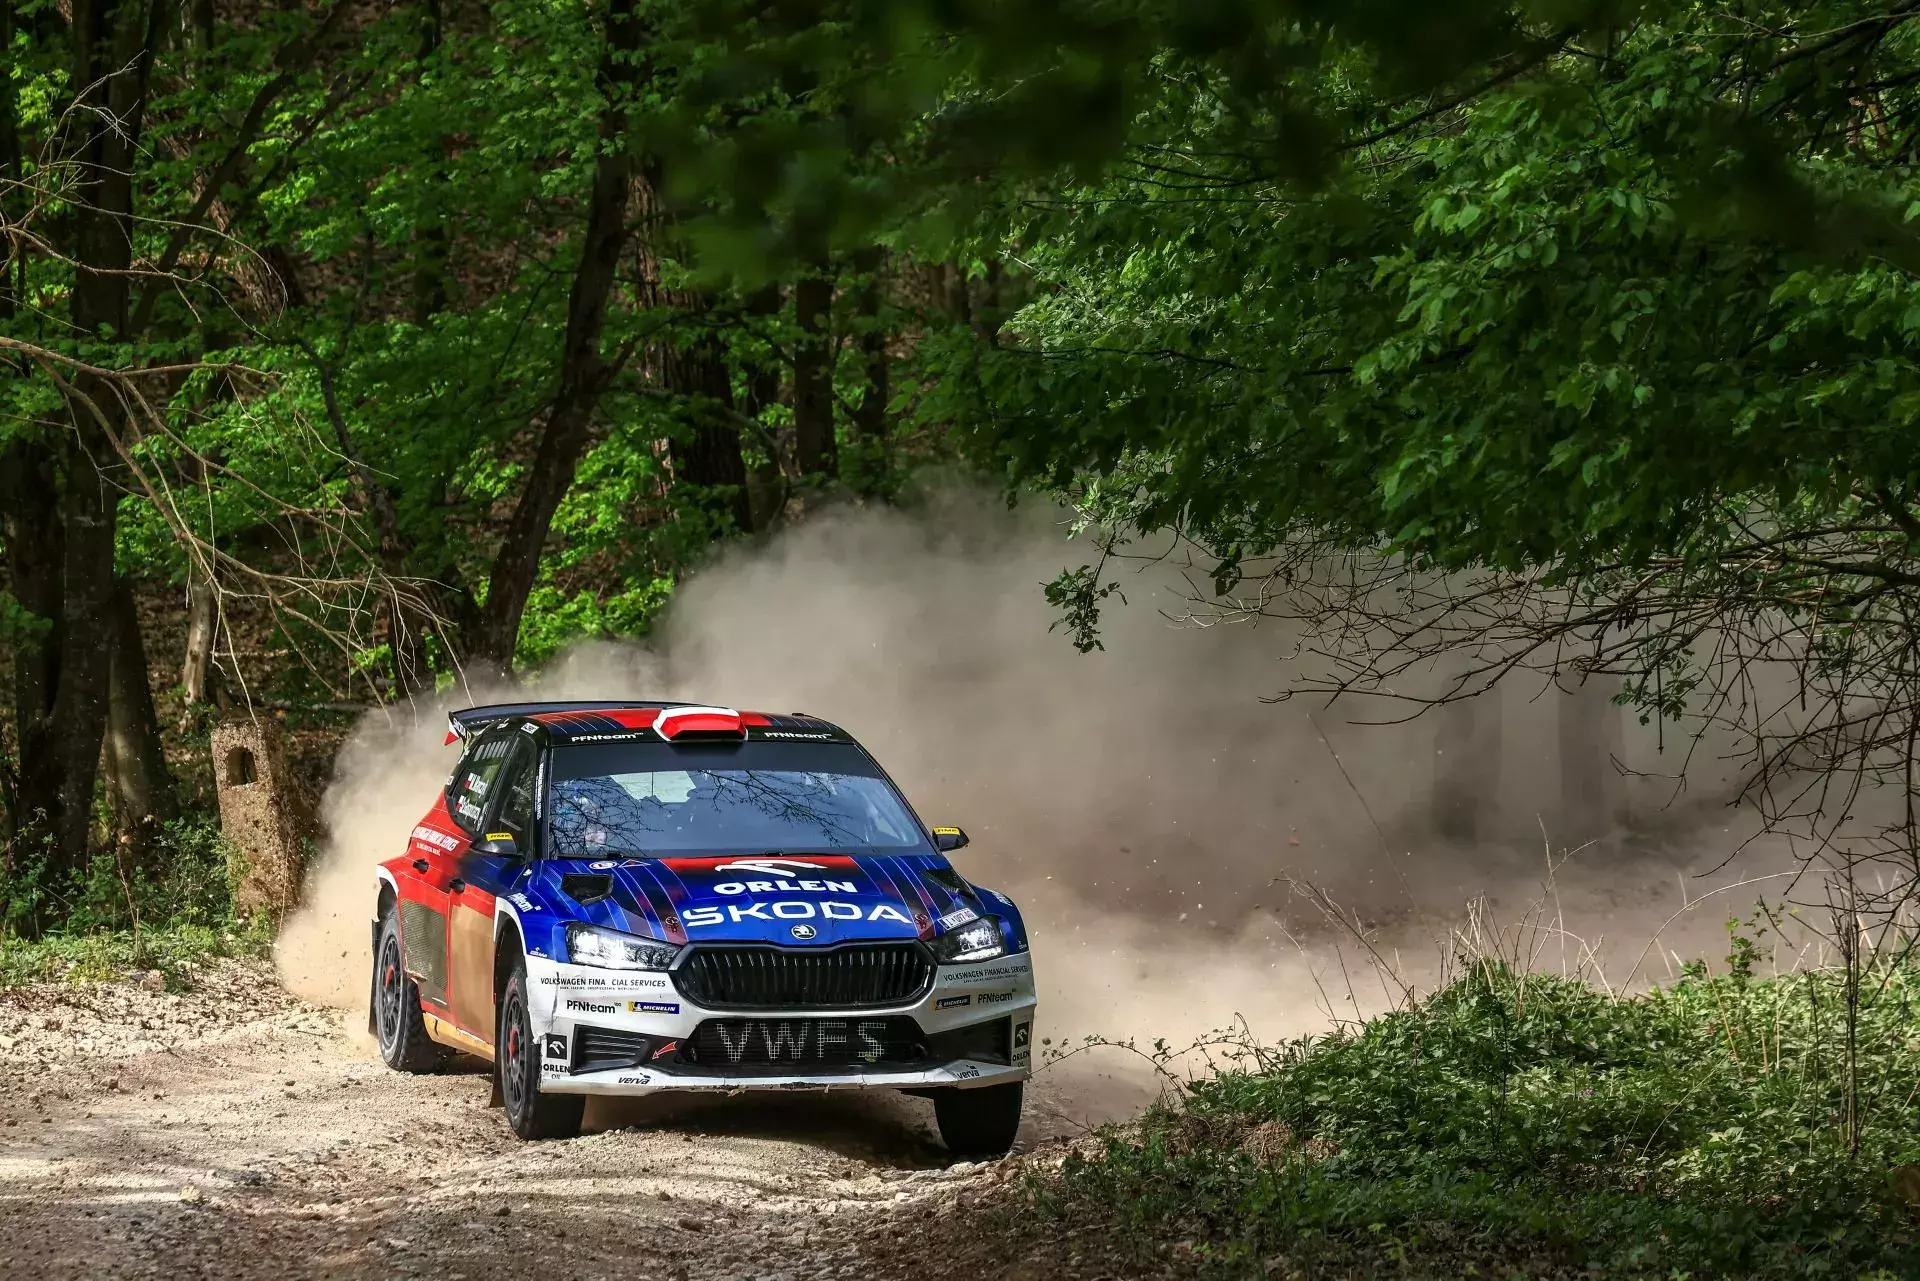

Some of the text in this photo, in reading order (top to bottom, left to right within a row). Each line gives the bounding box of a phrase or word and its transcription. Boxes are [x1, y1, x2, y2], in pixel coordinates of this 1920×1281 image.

[571, 733, 637, 742] PFNteam
[713, 879, 858, 895] ORLEN
[943, 970, 984, 982] VOLKSWAGEN
[540, 977, 586, 986] VOLKSWAGEN
[630, 978, 666, 988] SERVICES
[977, 992, 1013, 1005] PFNteam
[566, 999, 616, 1014] PFNteam
[716, 1021, 886, 1062] VWFS
[543, 1063, 570, 1073] ORLEN
[618, 1076, 651, 1086] verva
